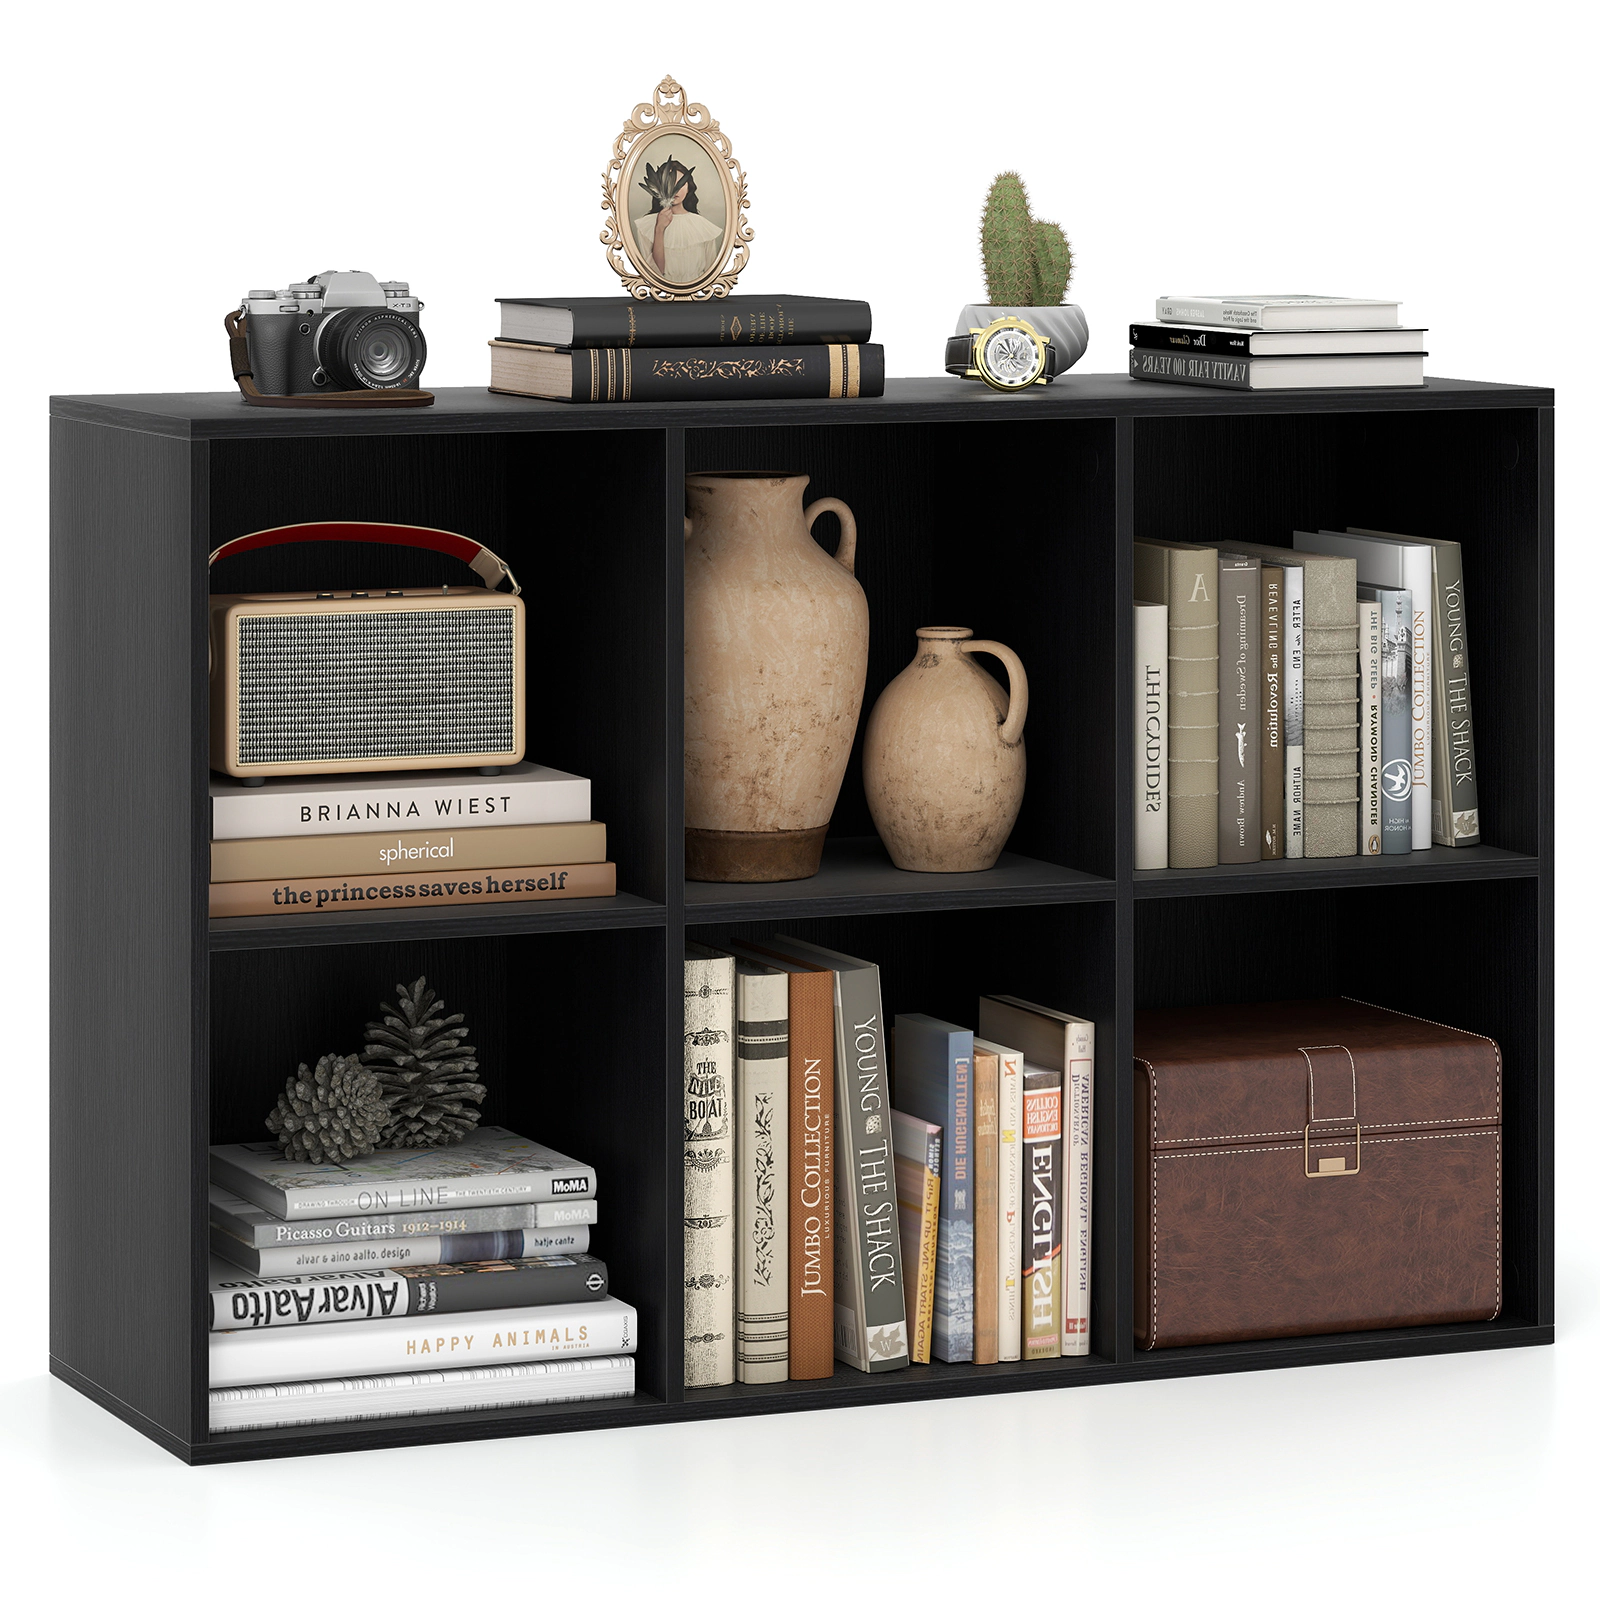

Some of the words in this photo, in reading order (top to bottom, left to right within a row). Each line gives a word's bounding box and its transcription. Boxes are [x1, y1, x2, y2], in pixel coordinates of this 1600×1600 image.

[1445, 580, 1464, 653] YOUNG
[1412, 610, 1425, 721] COLLECTION
[1448, 672, 1468, 714] THE
[1412, 728, 1428, 788] JUMBO
[1451, 719, 1472, 787] SHACK
[300, 800, 421, 823] BRIANNA
[434, 796, 512, 816] WIEST
[378, 837, 454, 866] spherical
[272, 886, 312, 906] the
[314, 878, 416, 909] princess
[418, 876, 482, 898] saves
[485, 871, 570, 894] herself
[696, 1060, 717, 1076] THE
[854, 1014, 882, 1112] YOUNG
[690, 1076, 723, 1096] NILE
[689, 1097, 724, 1120] BOAT
[801, 1058, 822, 1208] COLLECTION
[859, 1138, 889, 1195] THE
[358, 1190, 389, 1211] ON
[400, 1186, 449, 1208] LINE
[553, 1180, 587, 1193] MoMA
[553, 1208, 591, 1222] MoMA
[275, 1225, 333, 1242] Picasso
[336, 1220, 396, 1236] Guitars
[534, 1237, 553, 1248] hatje
[555, 1236, 575, 1246] cantz
[296, 1254, 320, 1265] alvar
[322, 1254, 328, 1264] &
[331, 1252, 350, 1263] aino
[381, 1247, 411, 1259] design
[801, 1216, 827, 1298] JUMBO
[863, 1202, 896, 1293] SHACK
[218, 1277, 304, 1290] Aalto
[308, 1270, 386, 1282] Alvar
[232, 1288, 315, 1326] Aalto
[318, 1282, 400, 1317] Alvar
[406, 1334, 474, 1355] HAPPY
[492, 1325, 588, 1348] ANIMALS
[880, 1339, 892, 1352] W
